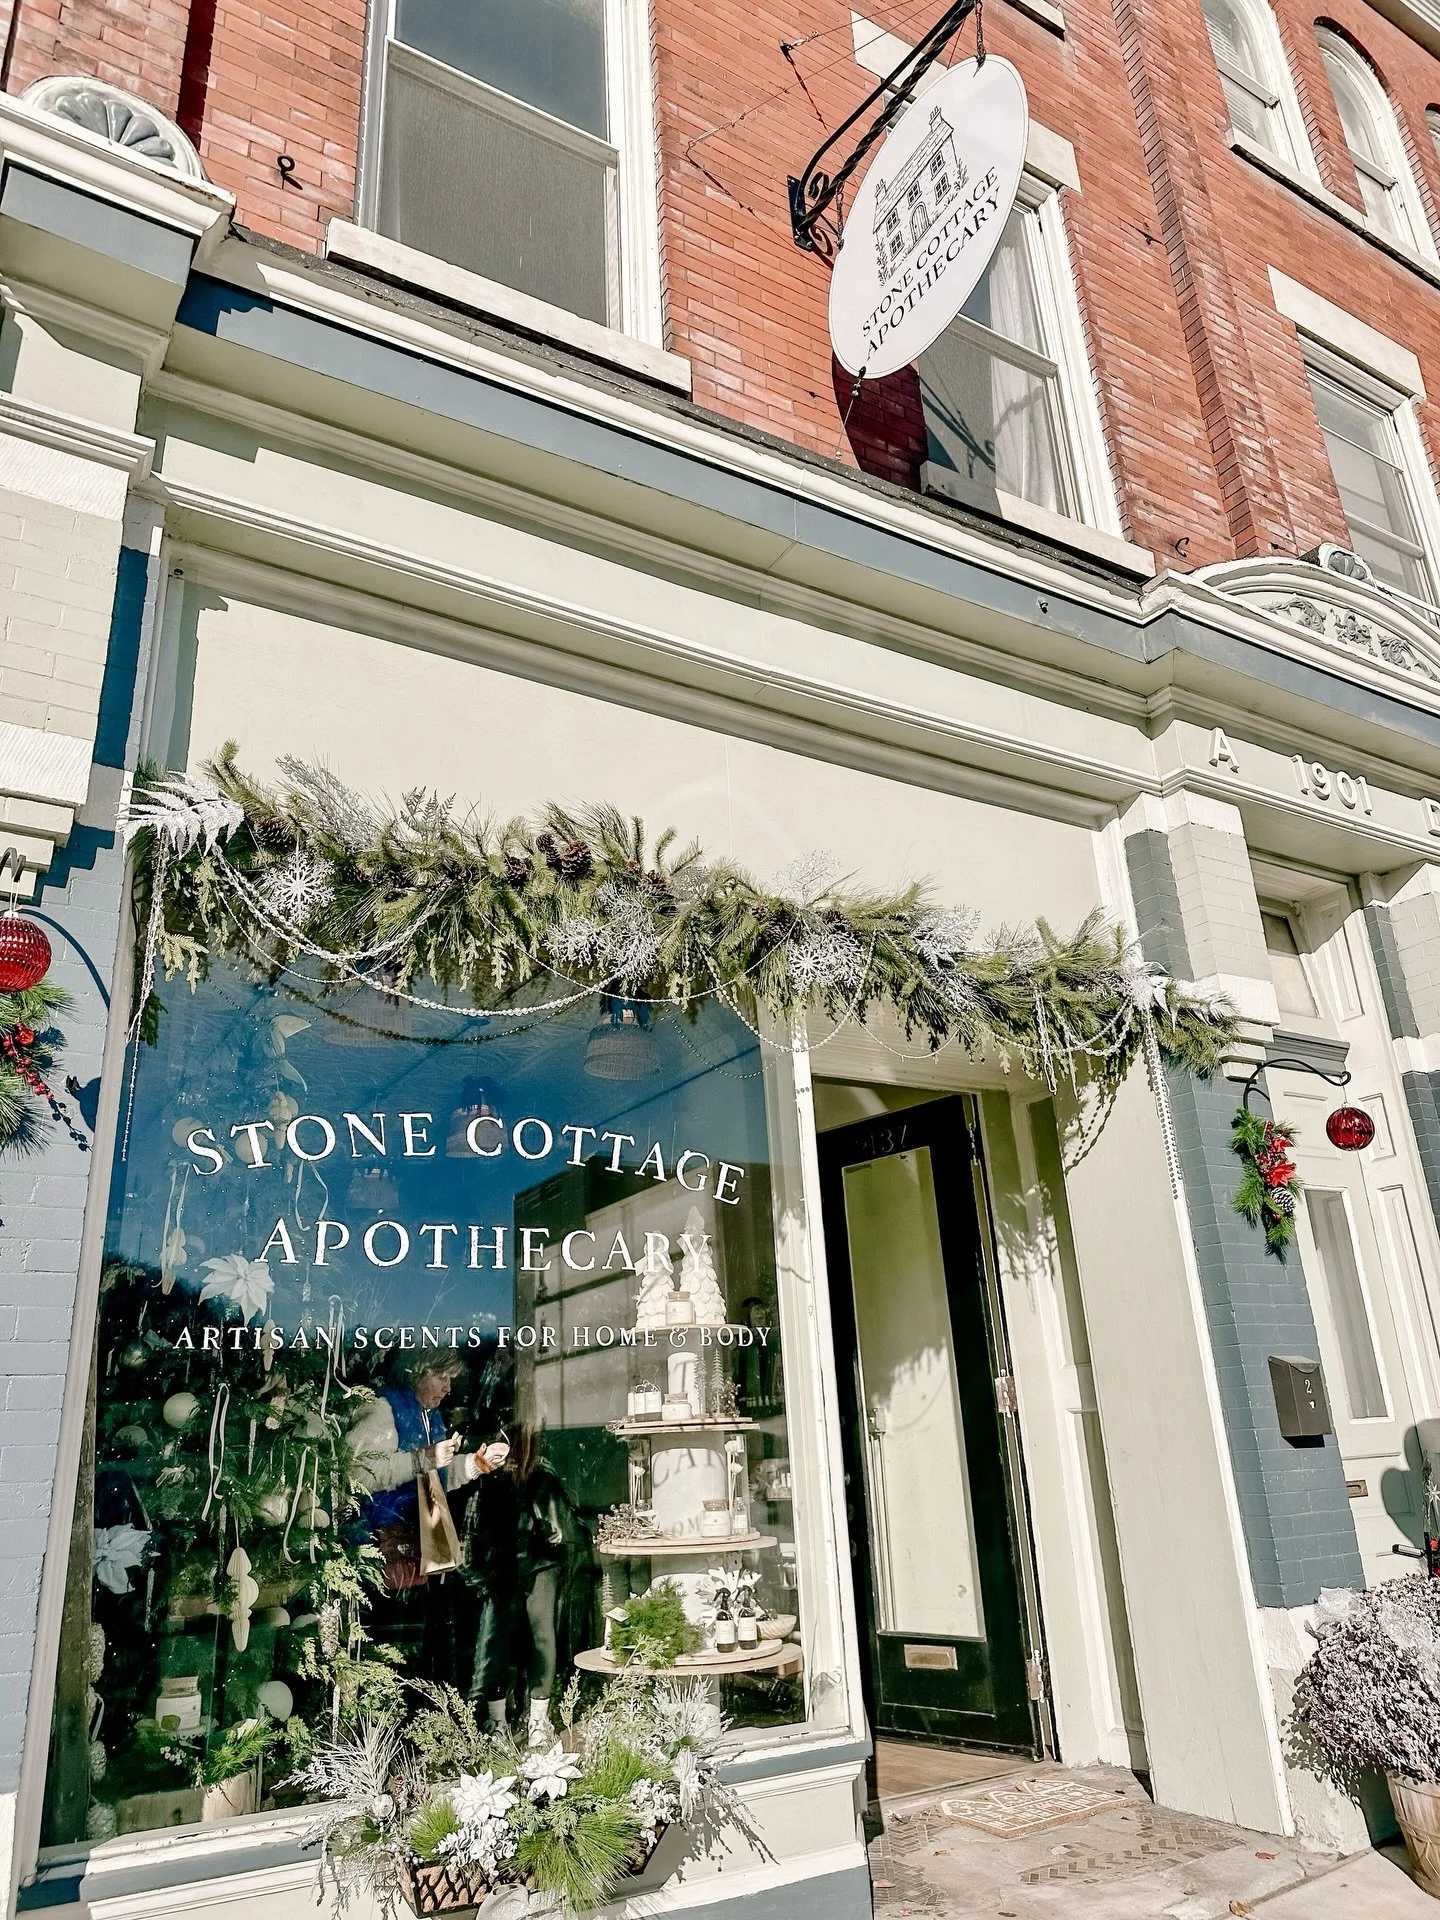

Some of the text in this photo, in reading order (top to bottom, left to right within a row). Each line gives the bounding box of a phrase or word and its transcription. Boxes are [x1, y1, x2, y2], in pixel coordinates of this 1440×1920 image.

[862, 166, 998, 338] STONE COTTAGE
[866, 185, 1000, 361] APOTHECARY
[1208, 727, 1240, 773] A
[1291, 754, 1373, 816] 1901
[186, 1112, 746, 1206] STONE COTTAGE
[254, 1217, 712, 1275] APOTHECARY
[173, 1325, 772, 1350] ARTISAN SCENTS FOR HOME & BODY
[1304, 1379, 1313, 1394] 2
